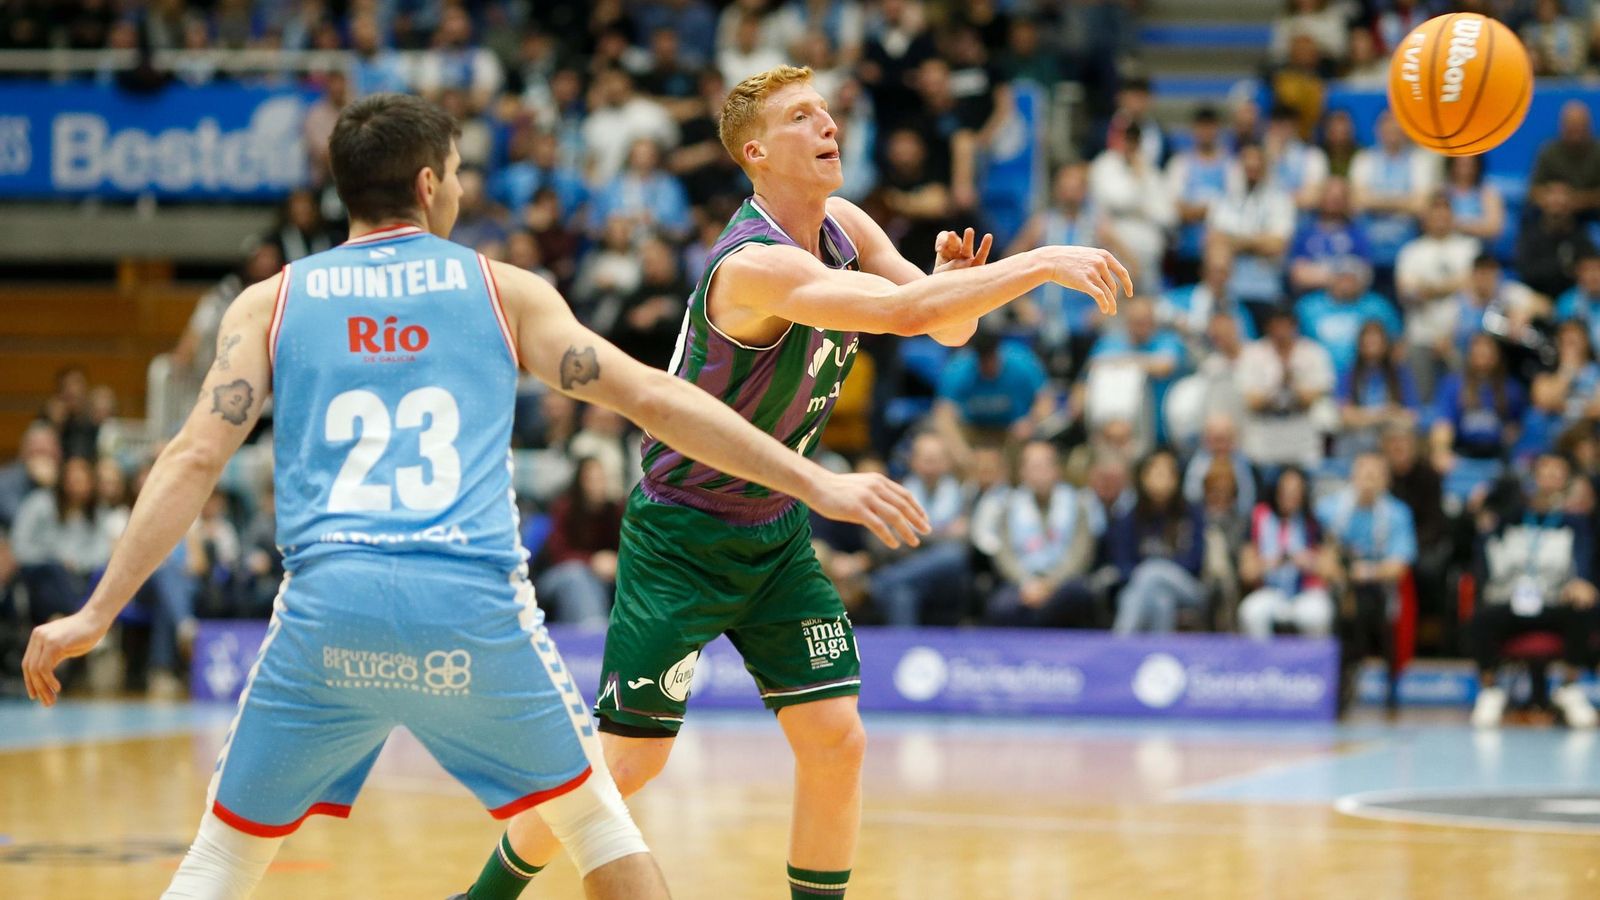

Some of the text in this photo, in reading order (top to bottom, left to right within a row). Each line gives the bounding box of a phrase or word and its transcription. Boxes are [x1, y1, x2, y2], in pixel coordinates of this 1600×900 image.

[1440, 19, 1482, 102] Wilson
[306, 258, 467, 299] QUINTELA
[325, 386, 461, 512] 23
[323, 646, 418, 667] DEPUTACIÓN
[805, 636, 850, 659] laga
[344, 660, 418, 681] LUGO
